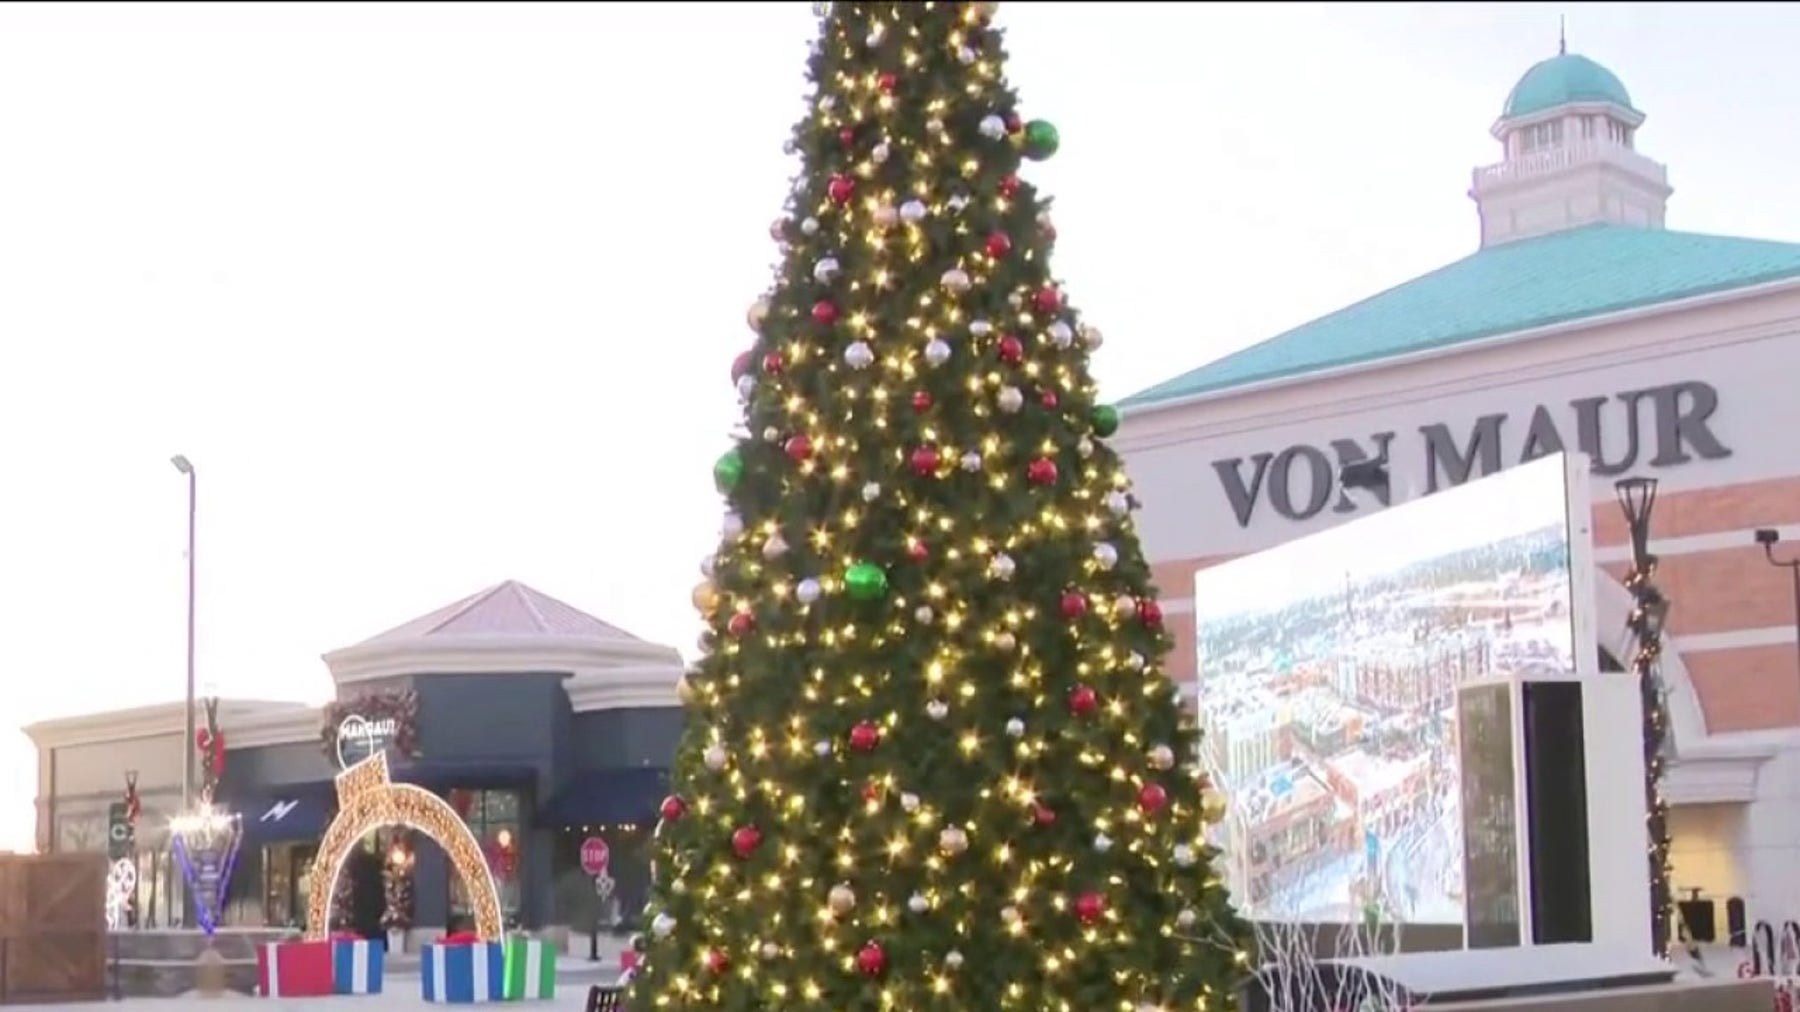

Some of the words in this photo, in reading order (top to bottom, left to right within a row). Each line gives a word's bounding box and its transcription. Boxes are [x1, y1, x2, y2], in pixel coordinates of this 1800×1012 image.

[1212, 431, 1396, 528] VON
[1418, 380, 1732, 496] MAUR
[582, 849, 607, 864] STOP
